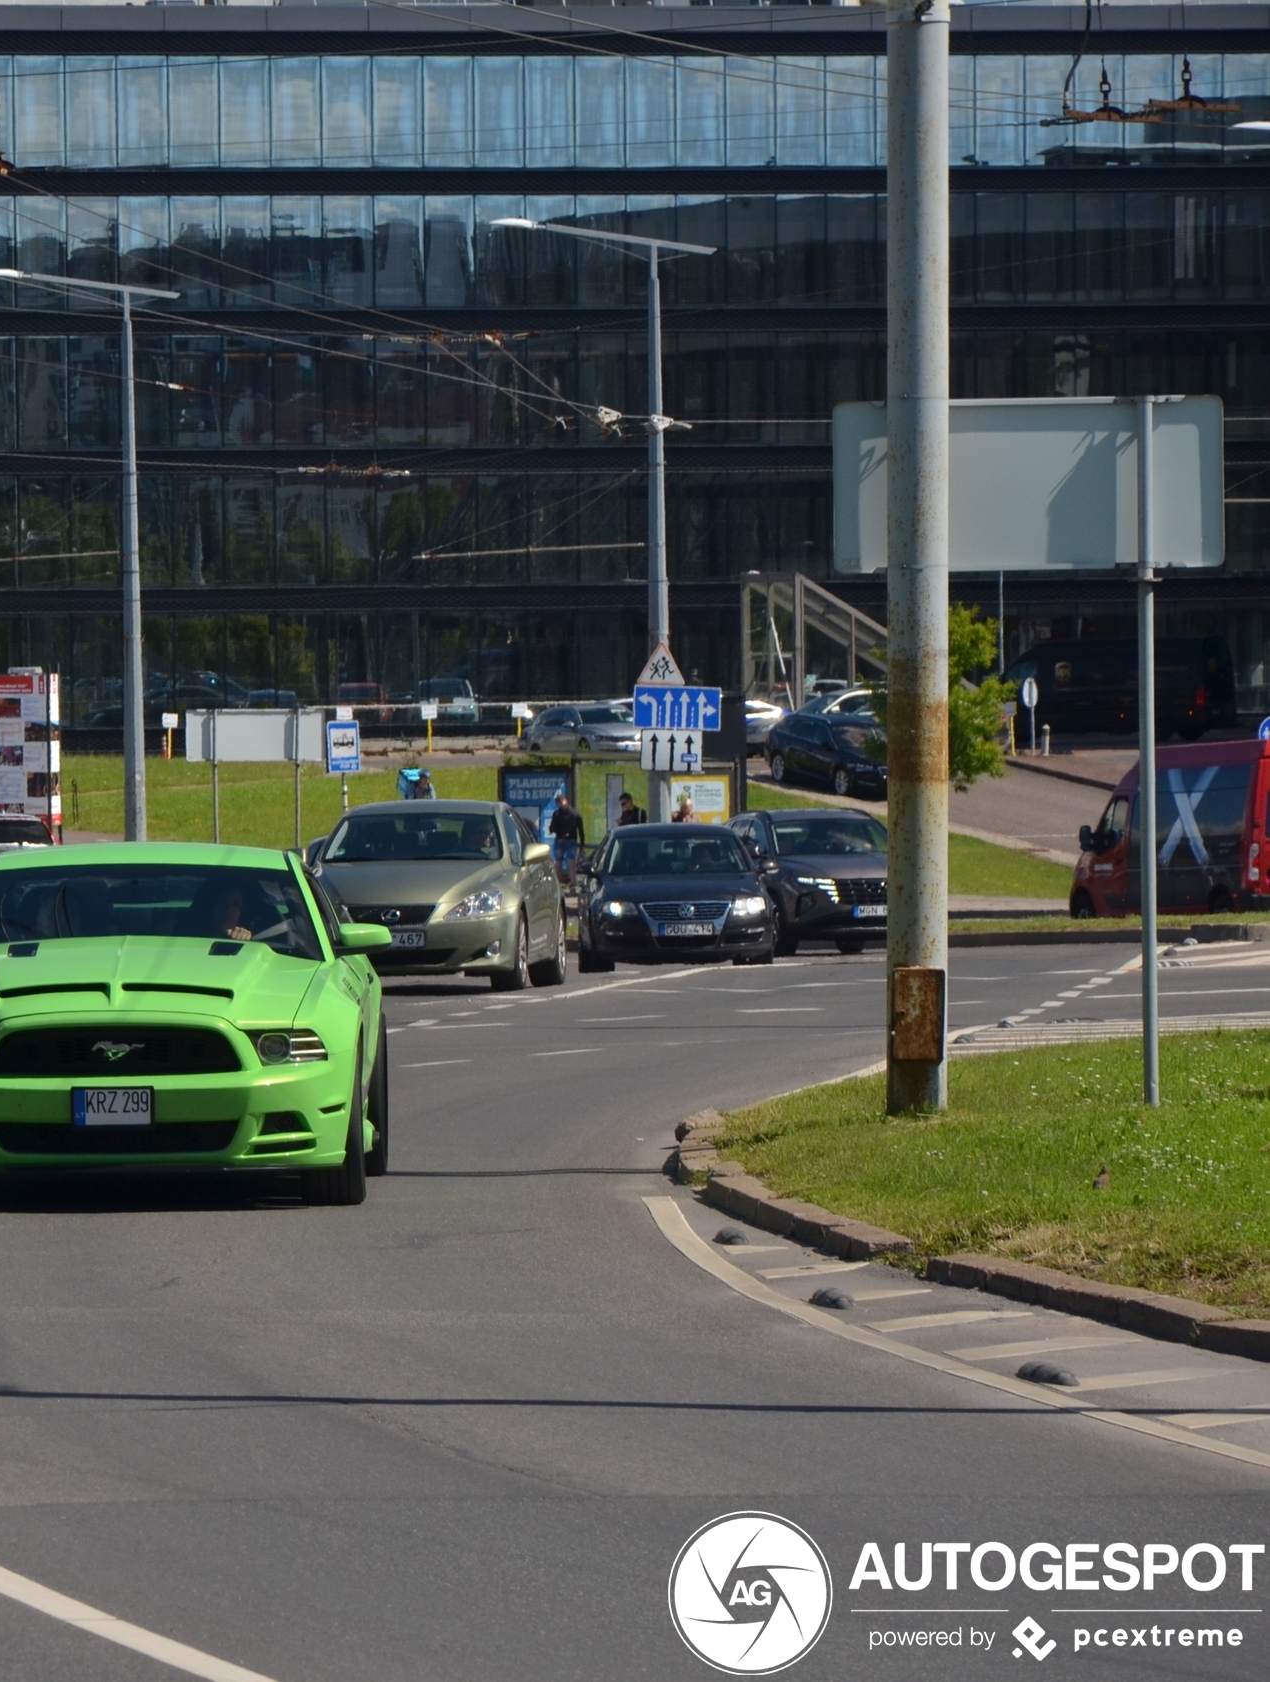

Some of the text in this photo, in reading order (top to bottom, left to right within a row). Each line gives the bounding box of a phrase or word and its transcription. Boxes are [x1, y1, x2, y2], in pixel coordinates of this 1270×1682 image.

[399, 933, 422, 945] 467
[86, 1090, 149, 1113] KRZ 299
